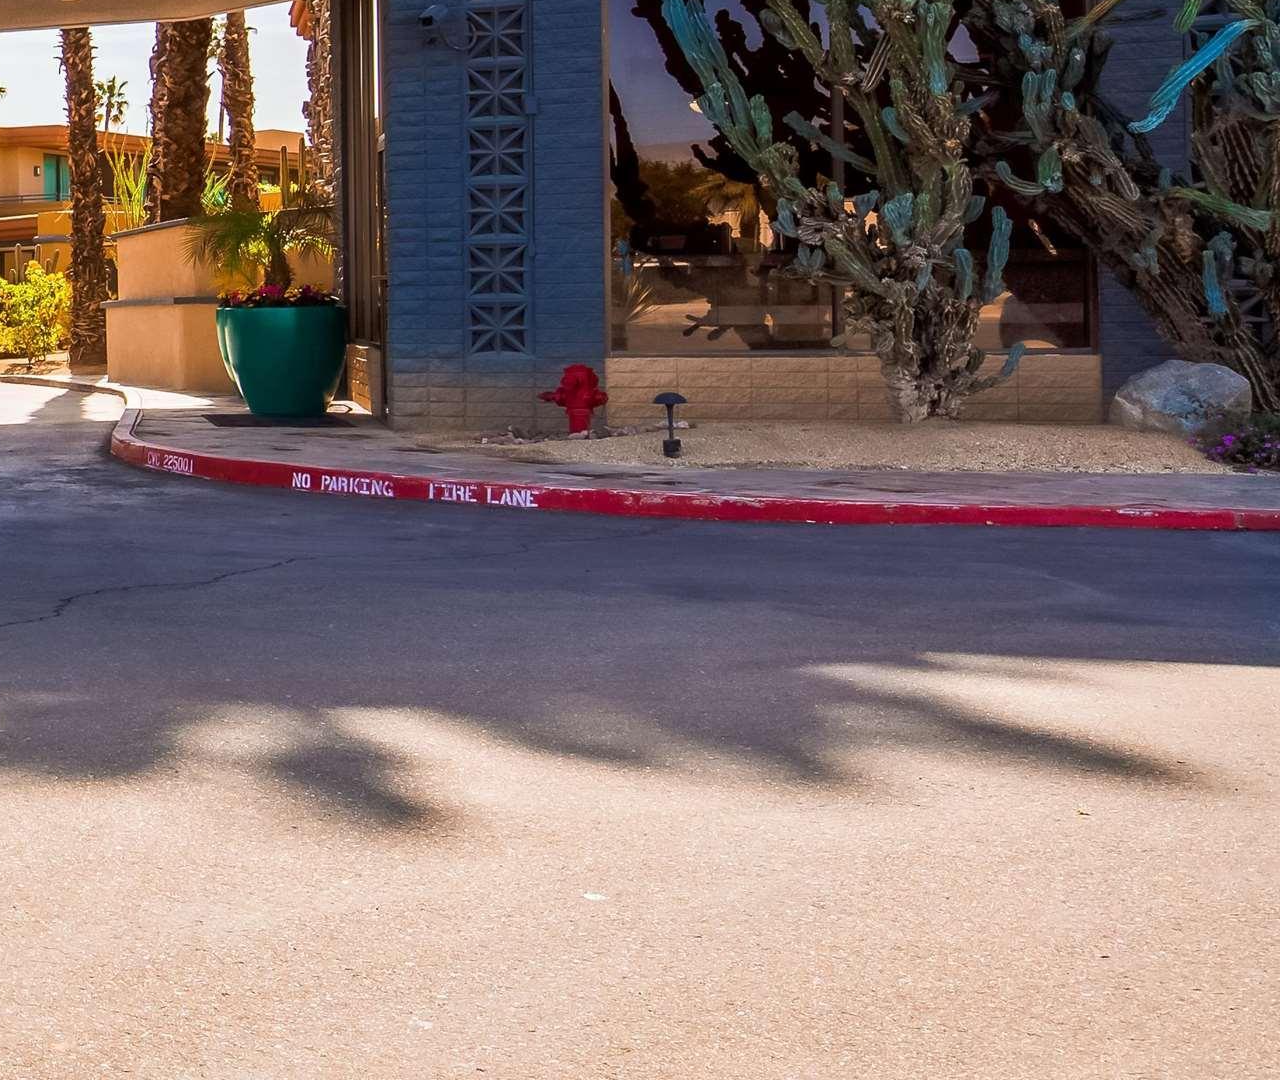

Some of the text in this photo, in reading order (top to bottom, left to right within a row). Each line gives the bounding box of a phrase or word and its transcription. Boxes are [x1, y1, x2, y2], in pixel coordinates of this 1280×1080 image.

[162, 454, 193, 473] 22500.1
[292, 472, 539, 508] NO PARKING FIRE LANE
